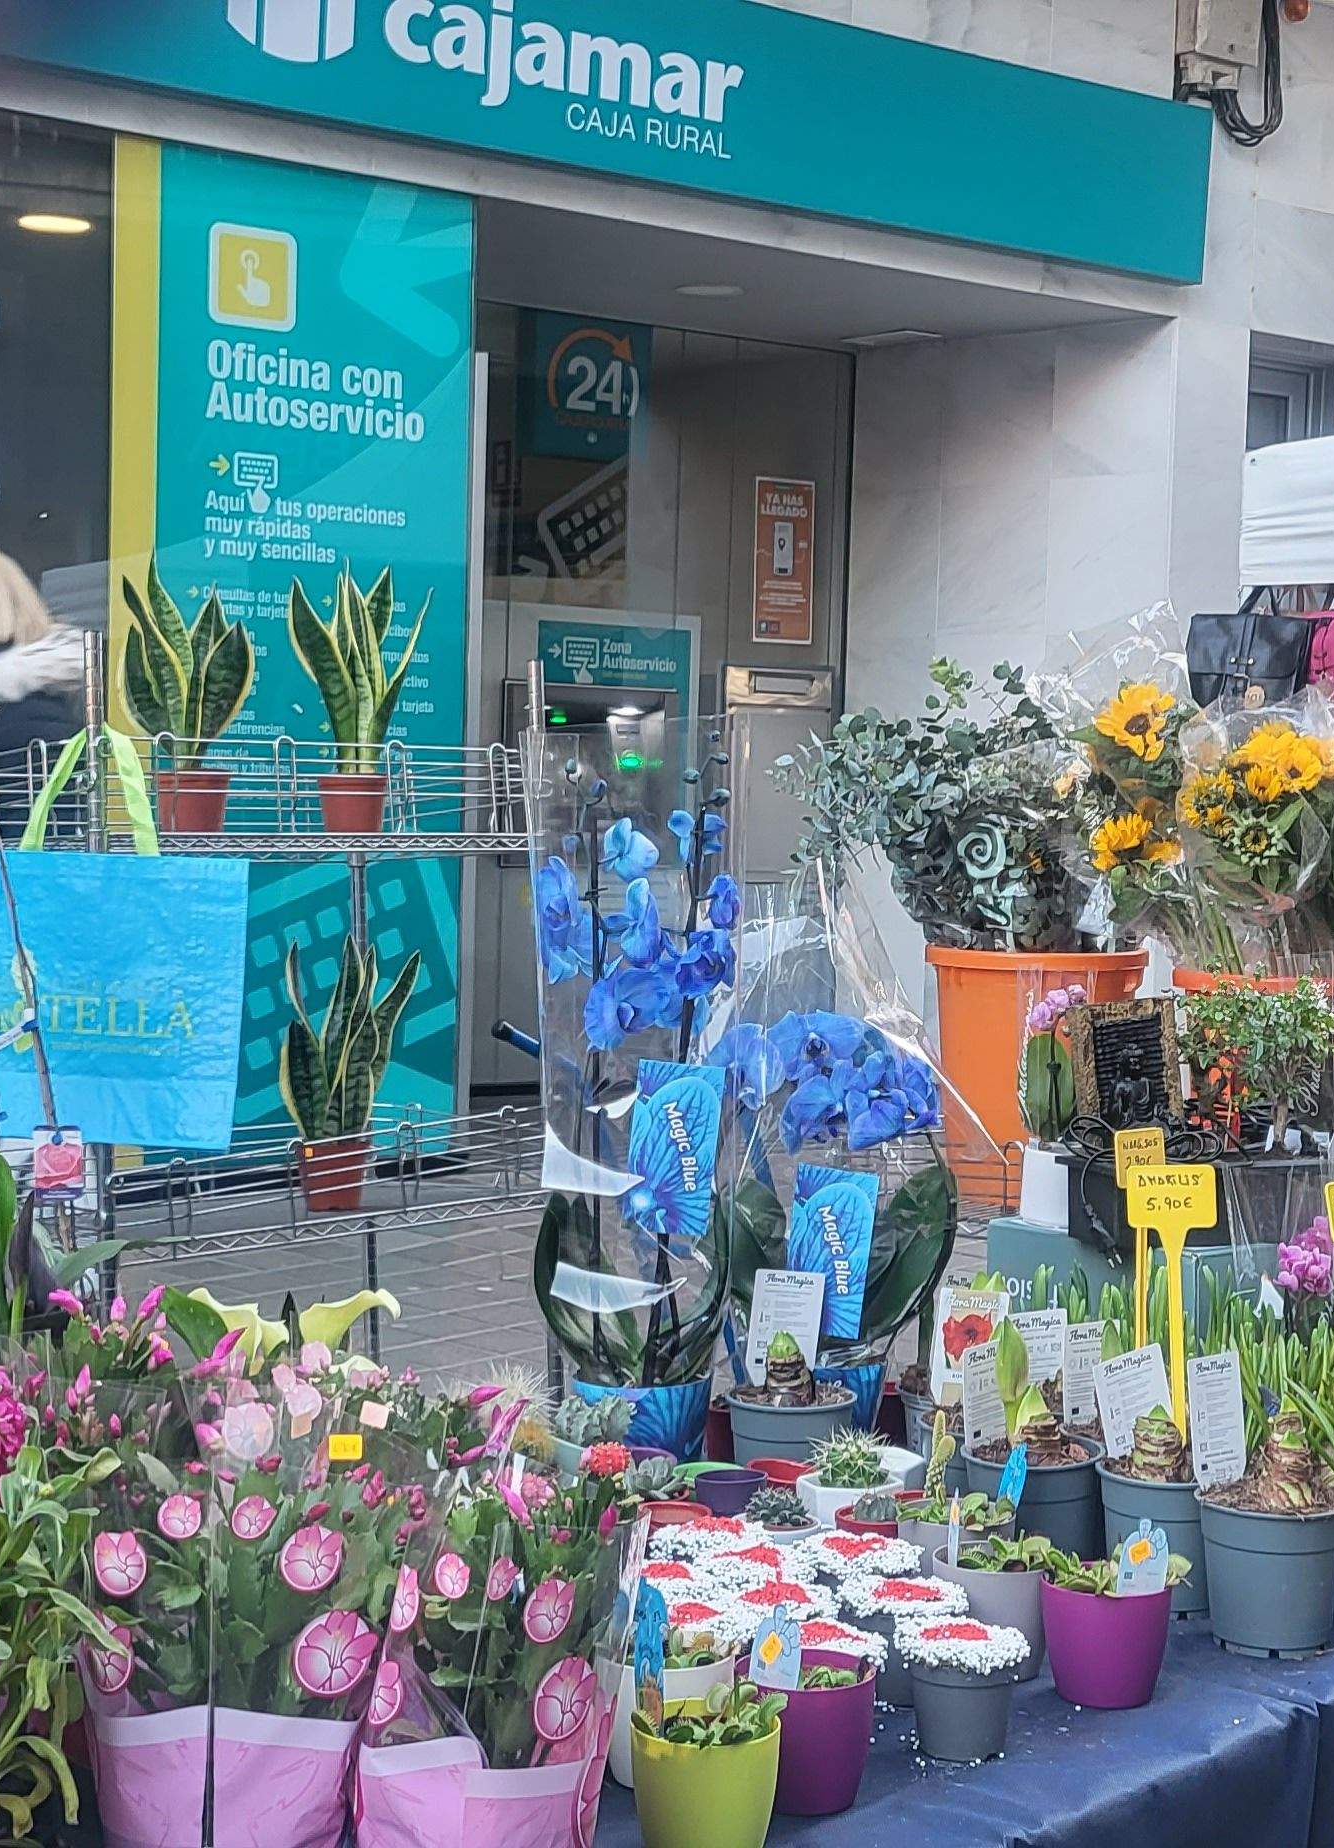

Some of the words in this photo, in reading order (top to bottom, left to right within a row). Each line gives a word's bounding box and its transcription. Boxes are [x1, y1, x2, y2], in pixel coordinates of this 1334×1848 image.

[384, 0, 744, 123] cajamar
[567, 103, 636, 141] CAJA
[646, 118, 732, 159] RURAL
[208, 339, 331, 391] Oficina
[342, 365, 403, 400] con
[205, 381, 425, 442] Autoservicio
[205, 489, 245, 515] Aquí
[275, 496, 302, 517] tus
[306, 502, 406, 527] operaciones
[204, 515, 244, 538] muy
[247, 515, 312, 540] rápidas
[204, 538, 216, 558] y
[220, 538, 258, 561] muy
[261, 541, 336, 564] sencillas
[202, 585, 255, 602] Cnsultas
[257, 590, 272, 603] de
[603, 638, 632, 654] Zona
[602, 655, 677, 673] Autoservicio
[402, 700, 435, 715] tarjeta
[662, 1100, 693, 1153] Magic
[681, 1156, 699, 1192] Blue
[818, 1205, 846, 1256] Magic
[834, 1260, 851, 1295] Blue
[765, 1273, 786, 1284] Flora
[786, 1275, 815, 1289] Magica
[1031, 1315, 1062, 1332] Magica
[1067, 1327, 1087, 1342] Flora
[967, 1351, 986, 1366] Flora
[1103, 1362, 1124, 1378] Flora
[1123, 1353, 1153, 1370] Magica
[1195, 1360, 1211, 1376] Flora
[1210, 1358, 1233, 1374] Magica
